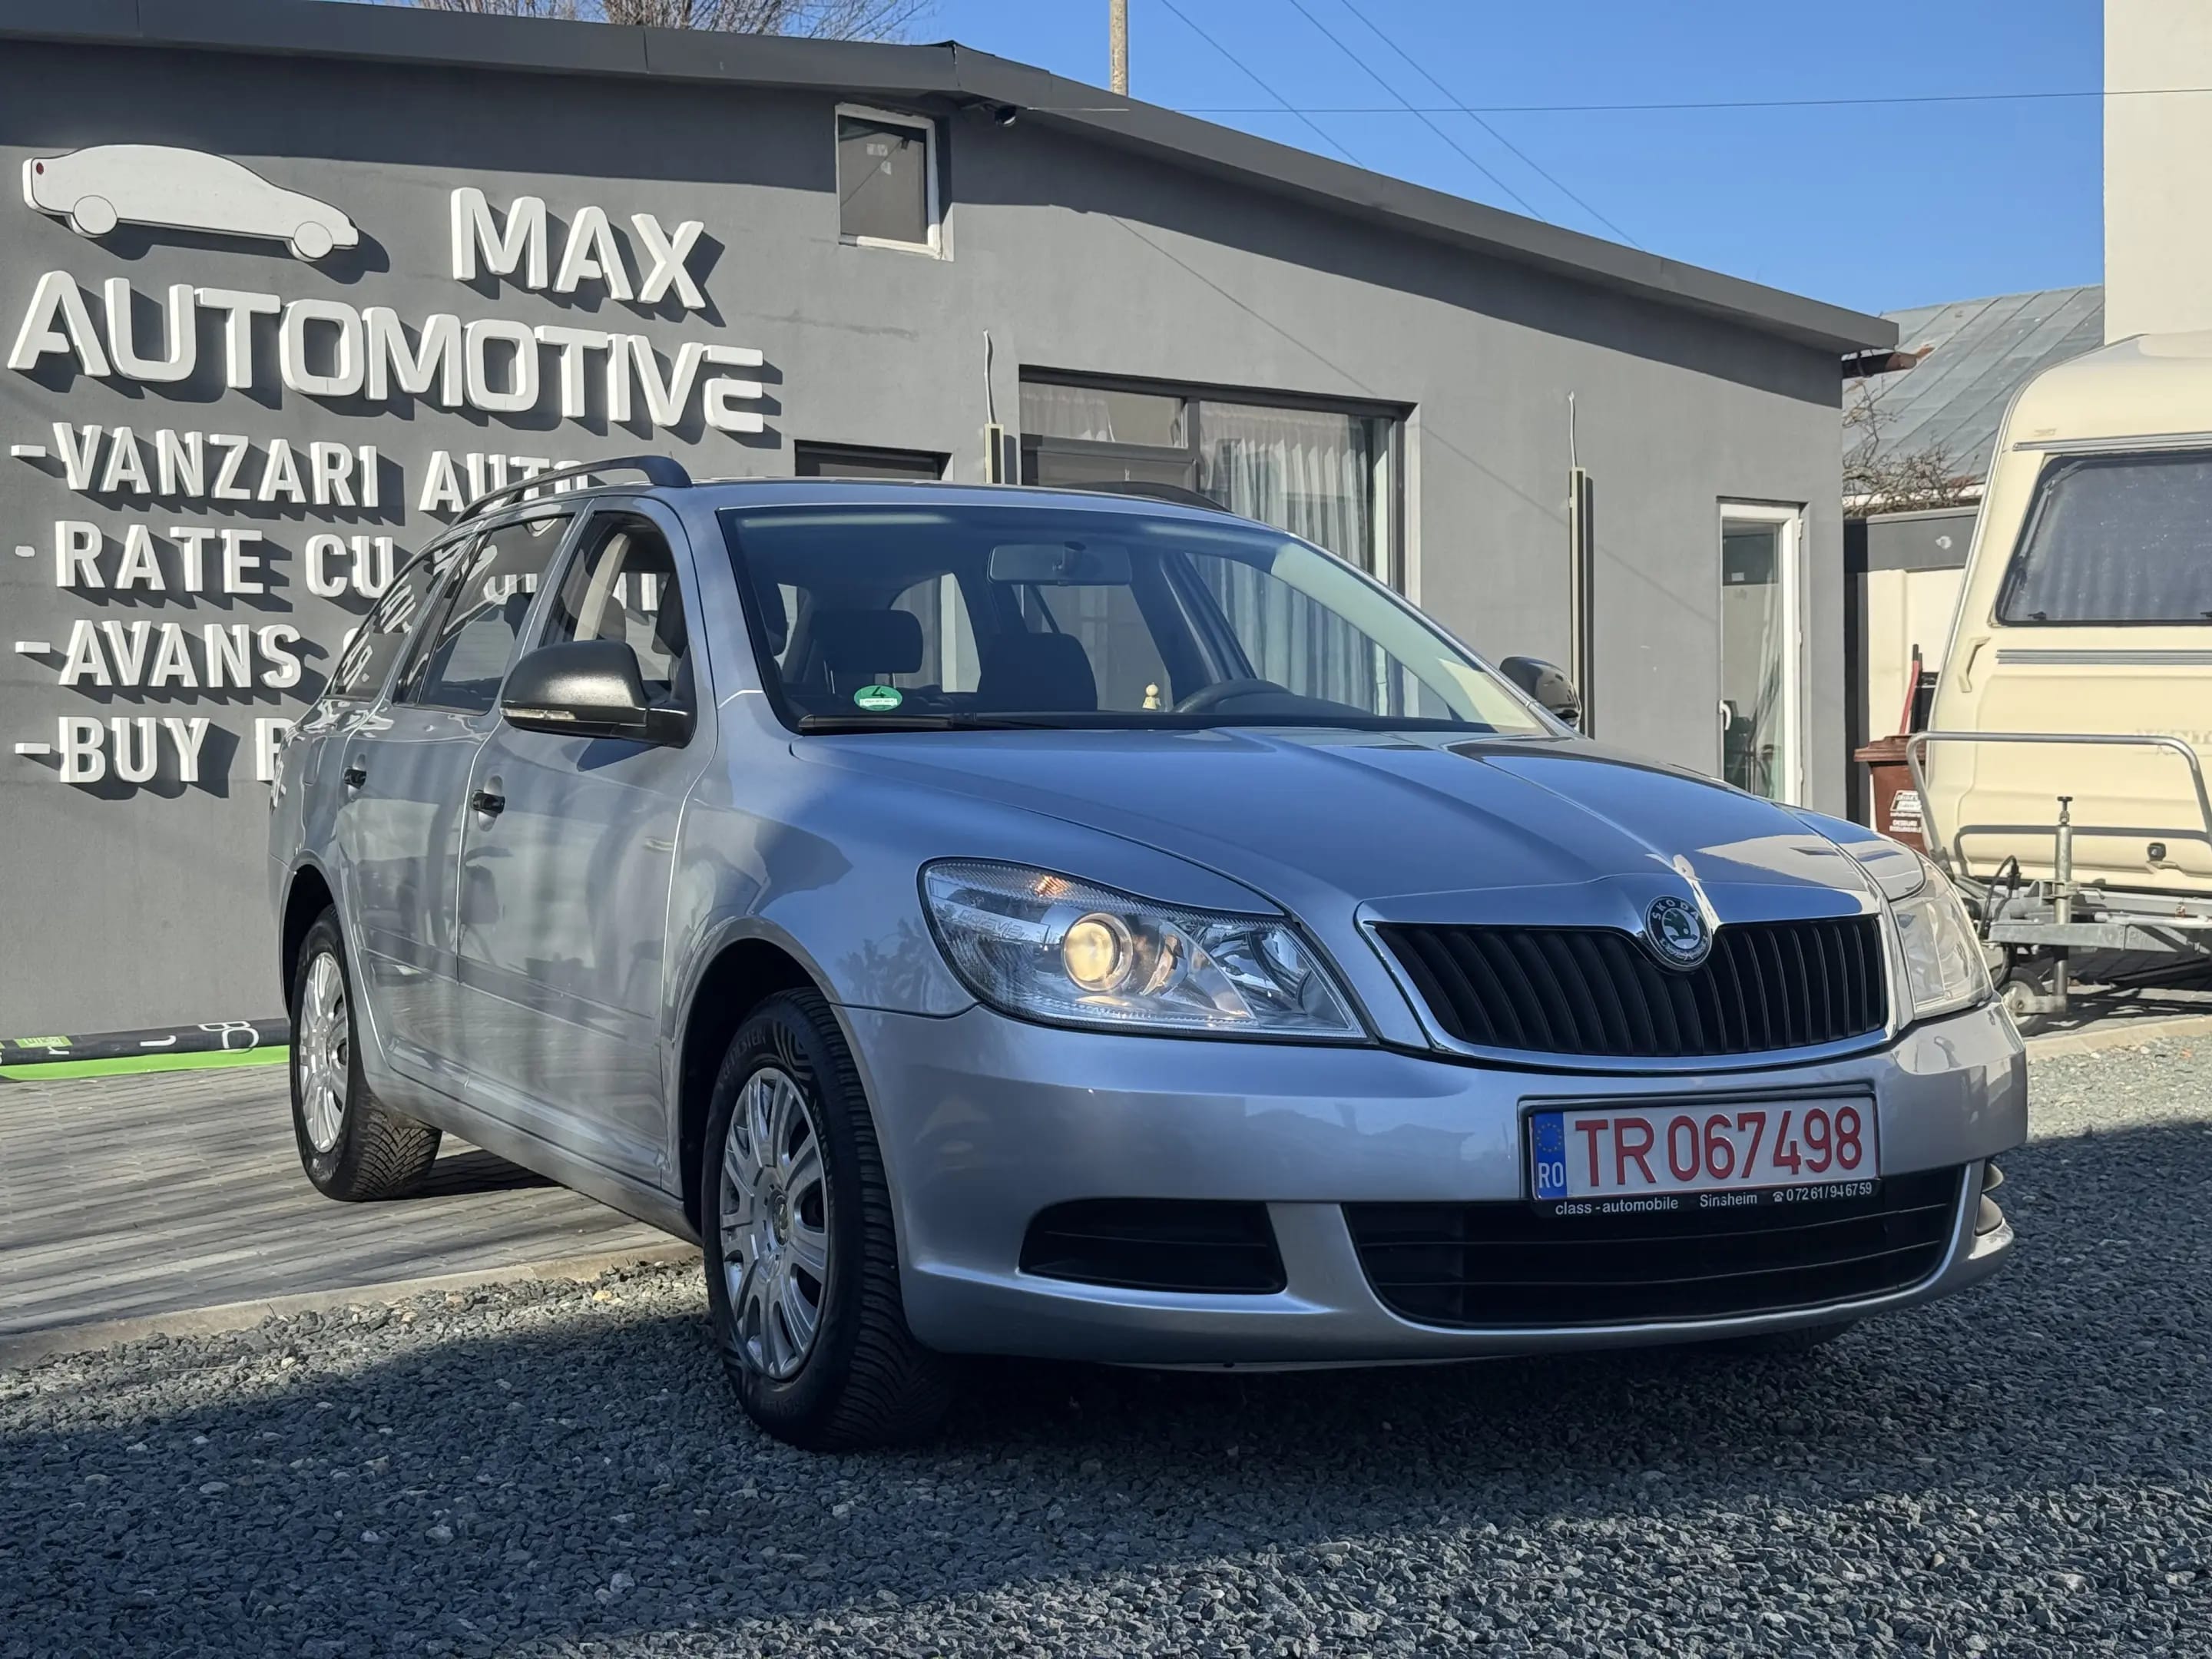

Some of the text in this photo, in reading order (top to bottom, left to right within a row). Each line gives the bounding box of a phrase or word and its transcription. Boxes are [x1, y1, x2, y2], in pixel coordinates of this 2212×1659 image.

[451, 187, 706, 310] MAX
[6, 270, 764, 432] AUTOMOTIVE
[306, 533, 394, 598] CU
[1538, 1161, 1564, 1188] RO
[1699, 1192, 1758, 1208] Sinsheim
